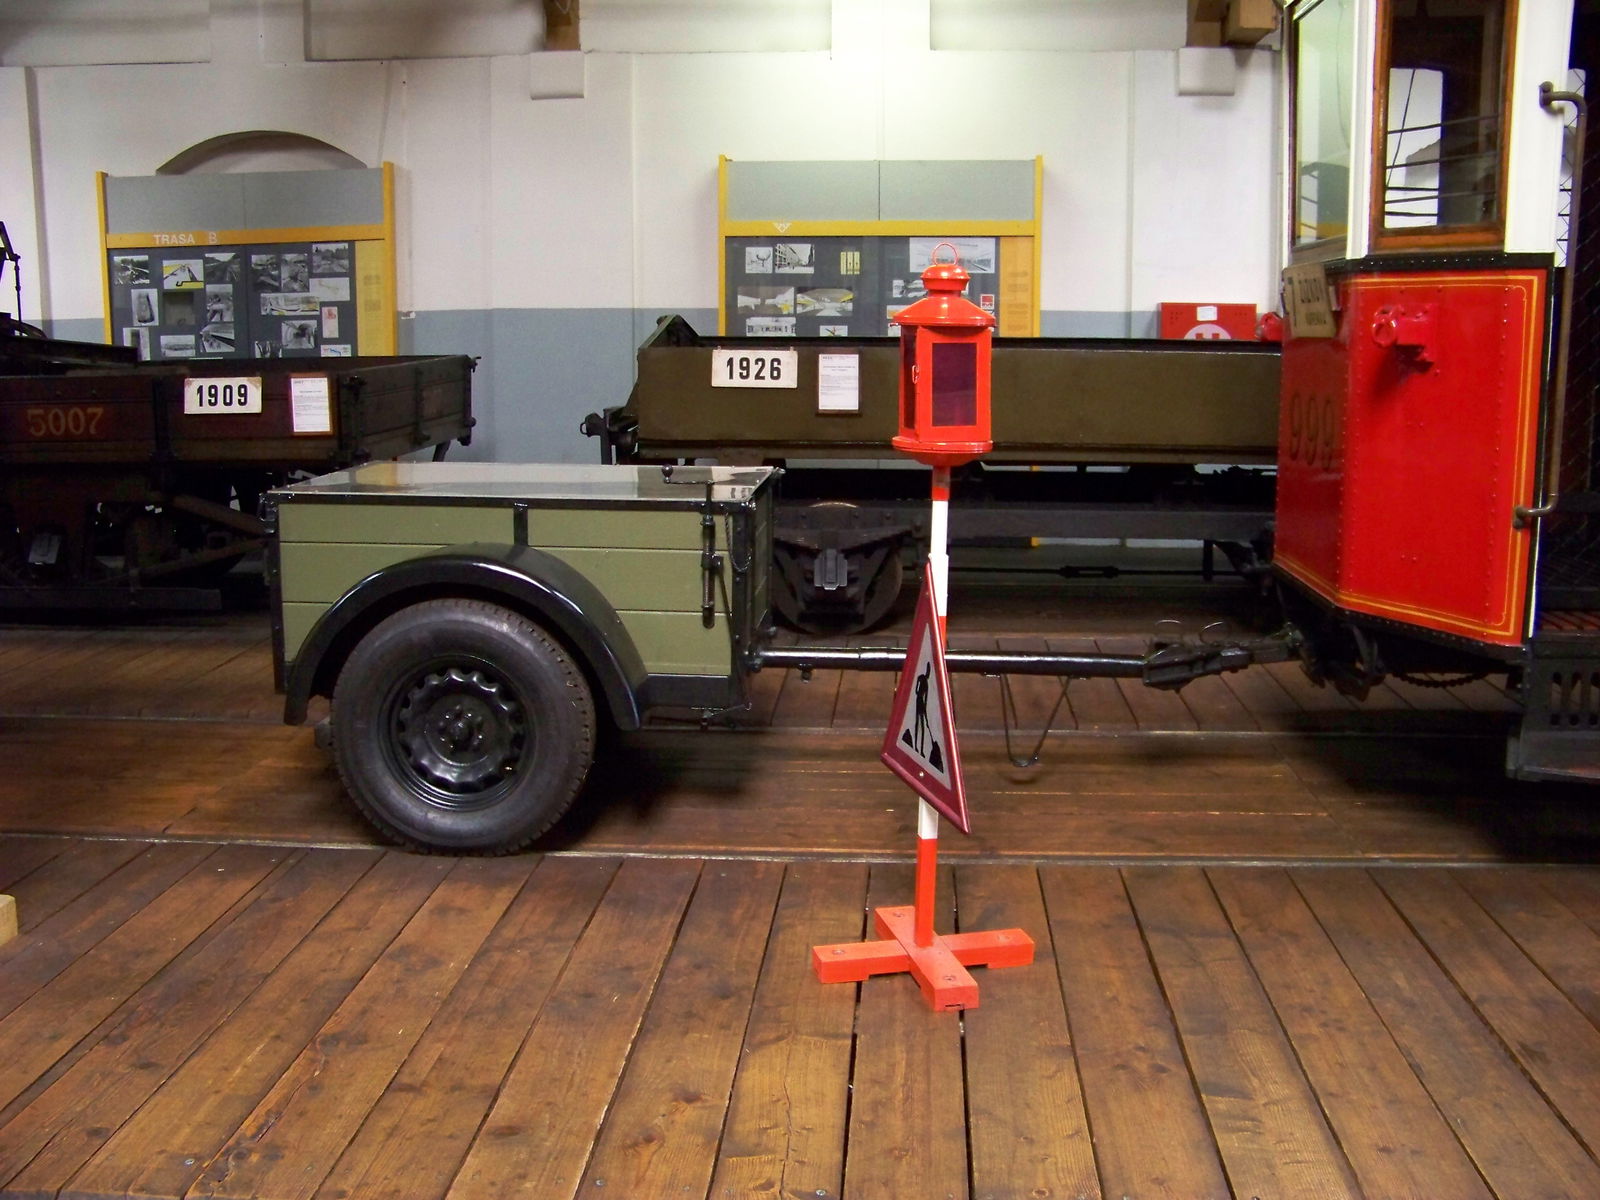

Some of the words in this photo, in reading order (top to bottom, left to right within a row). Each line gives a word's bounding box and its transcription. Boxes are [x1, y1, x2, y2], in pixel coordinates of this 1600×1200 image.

[153, 233, 195, 245] TRASA
[208, 231, 218, 244] B
[726, 357, 781, 380] 1926
[196, 384, 248, 407] 1909
[27, 407, 104, 436] 5007
